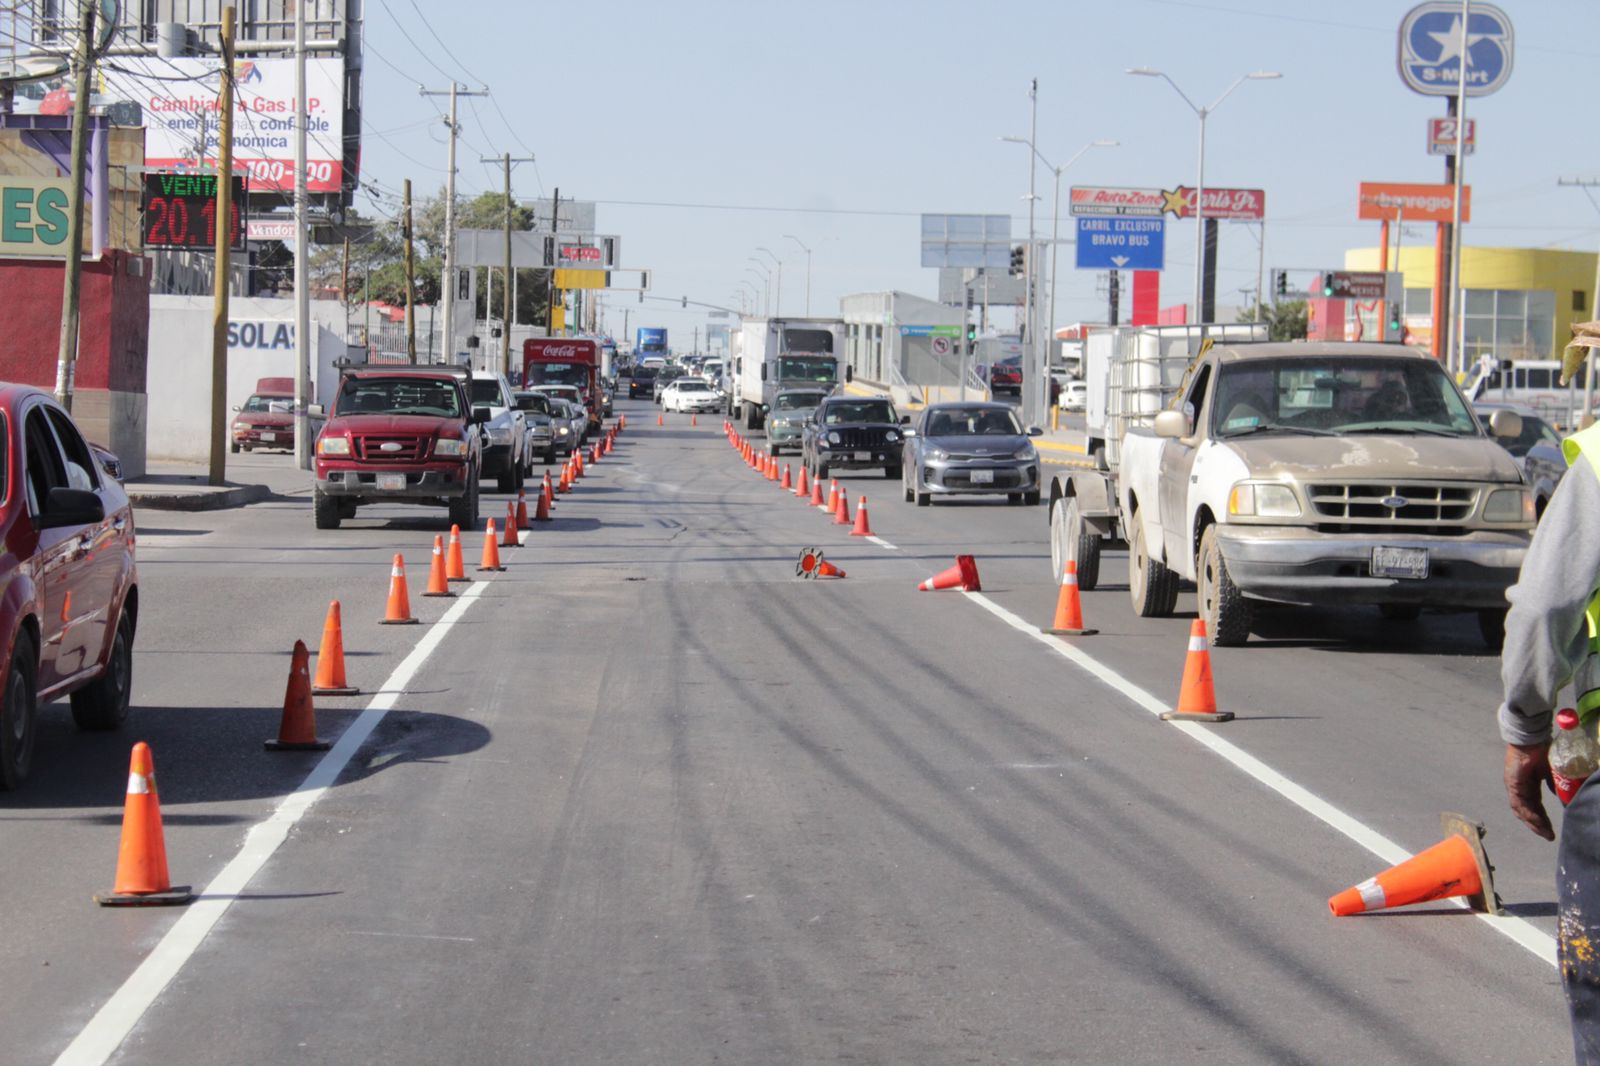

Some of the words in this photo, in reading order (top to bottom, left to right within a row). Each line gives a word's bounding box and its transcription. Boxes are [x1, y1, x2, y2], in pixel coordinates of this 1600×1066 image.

[253, 97, 285, 112] Gas
[260, 116, 329, 131] confble
[1094, 190, 1164, 204] AutoZone
[2, 187, 70, 246] ES
[1080, 220, 1111, 231] CARRIL
[1115, 221, 1162, 232] EXCLUSIVO
[1092, 234, 1125, 246] BRAVO
[1128, 235, 1149, 246] BUS
